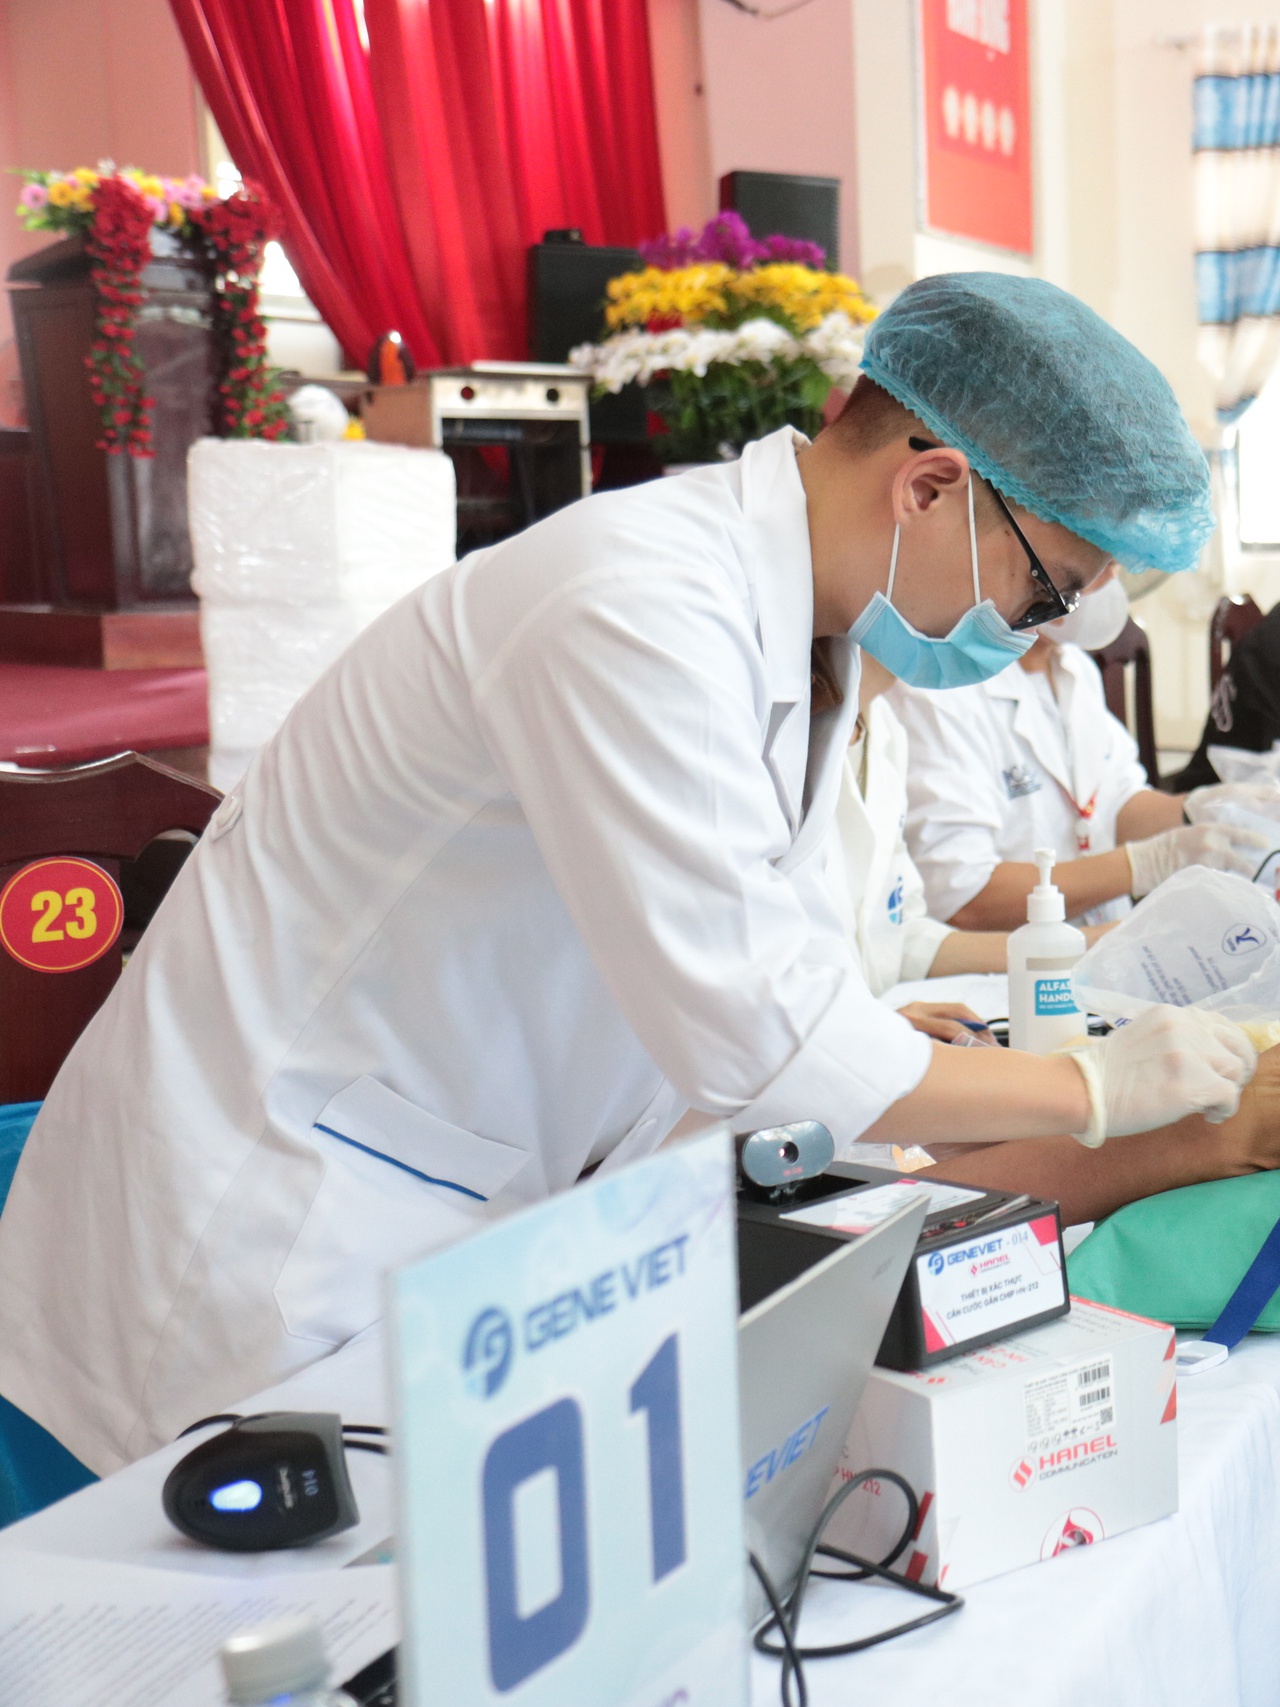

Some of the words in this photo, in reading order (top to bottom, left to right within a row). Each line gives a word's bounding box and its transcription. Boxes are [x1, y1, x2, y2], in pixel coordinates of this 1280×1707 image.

[31, 887, 97, 943] 23
[1039, 982, 1071, 991] ALFAS
[947, 1238, 1003, 1266] GENEVIET
[1012, 1231, 1029, 1245] 014
[526, 1234, 690, 1353] GENEVIET
[745, 1405, 830, 1499] EVIET
[1039, 1434, 1118, 1470] HANEL
[1039, 1449, 1118, 1480] COMMUNICATION
[482, 1330, 687, 1697] 01
